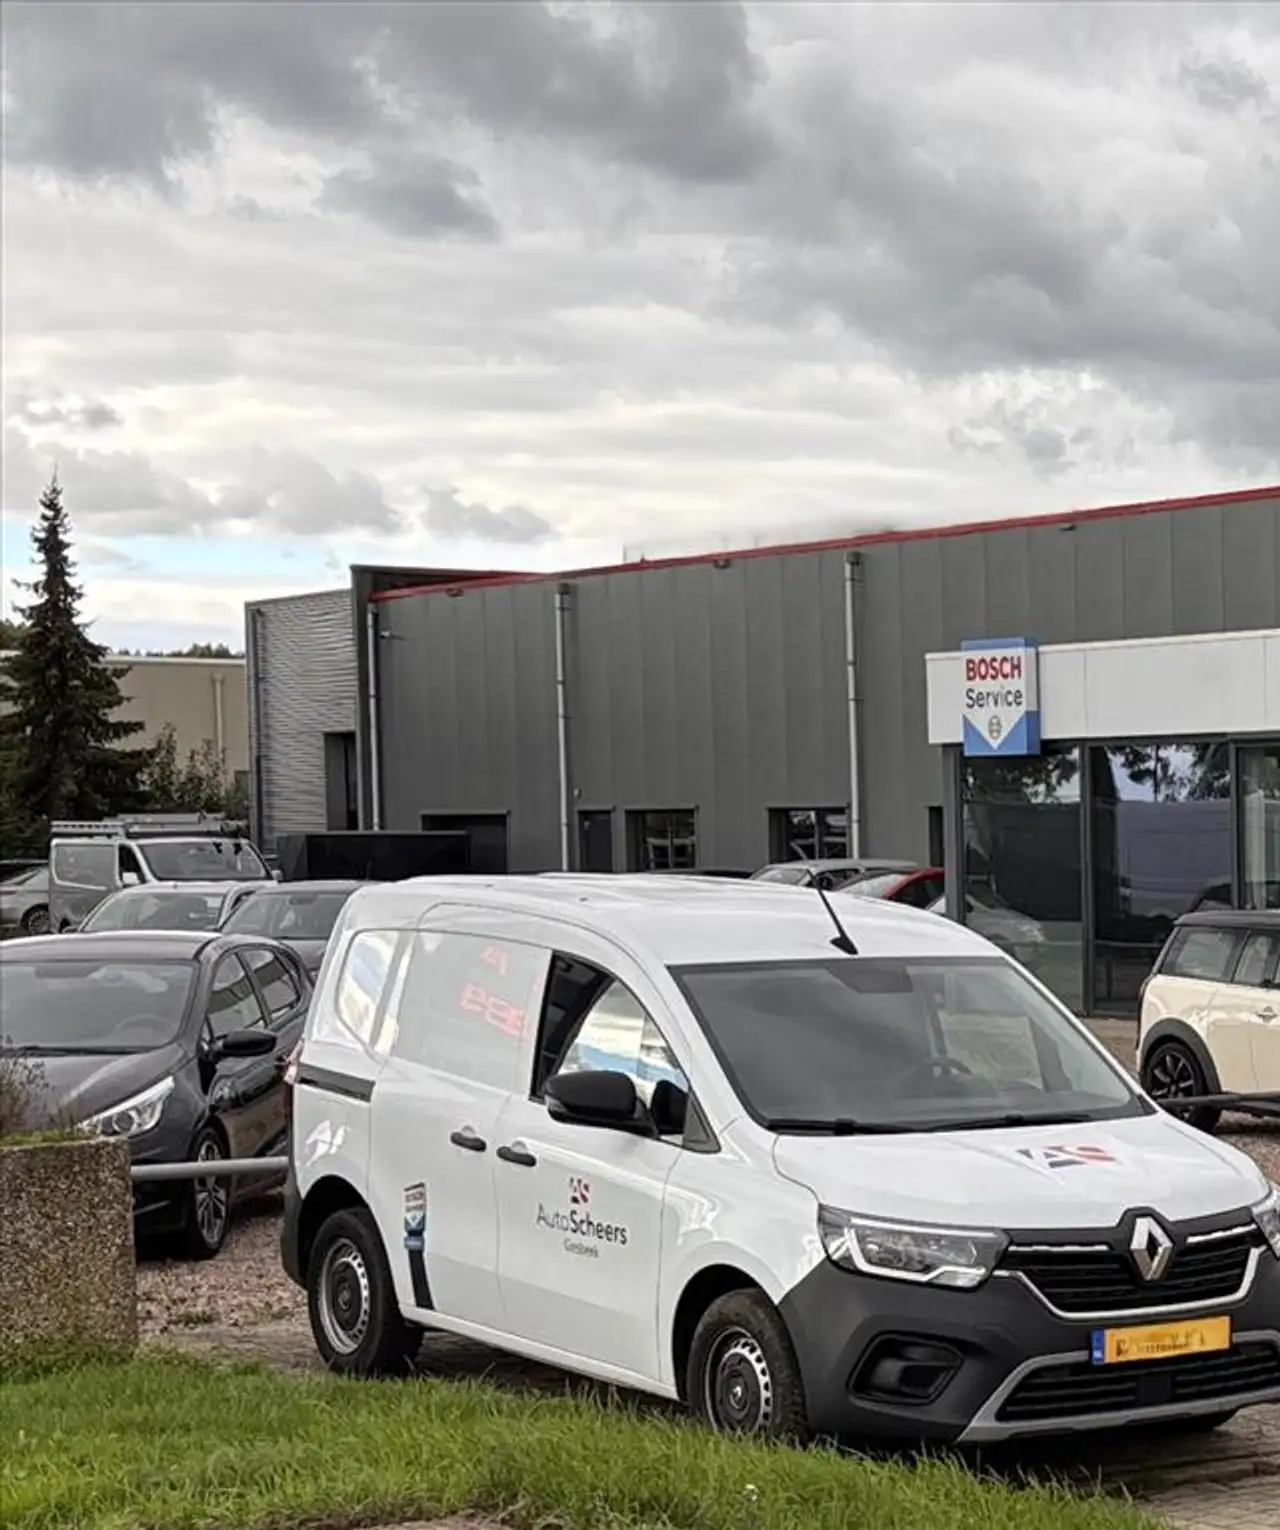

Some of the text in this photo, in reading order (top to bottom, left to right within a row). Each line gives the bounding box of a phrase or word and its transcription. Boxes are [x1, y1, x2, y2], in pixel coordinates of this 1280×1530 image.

[965, 655, 1022, 681] BOSCH
[965, 684, 1024, 710] Service
[535, 1202, 629, 1246] AutoScheers
